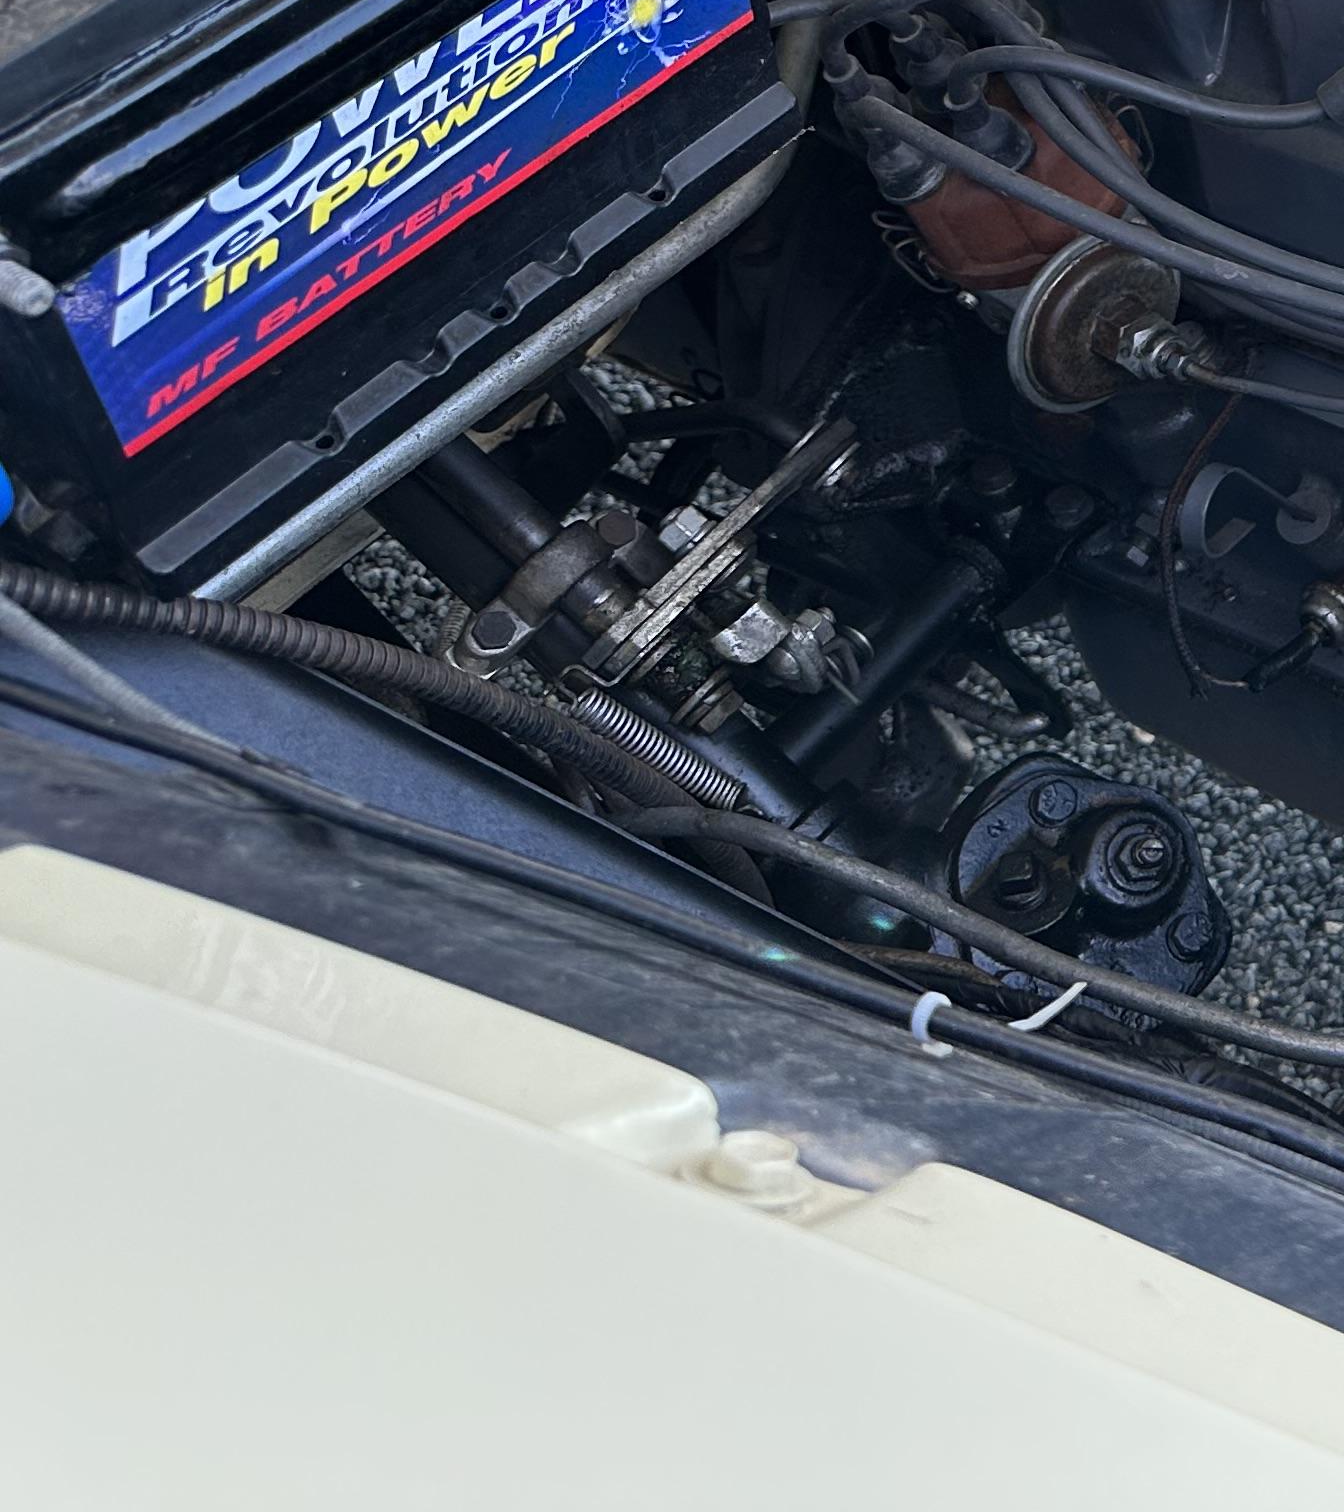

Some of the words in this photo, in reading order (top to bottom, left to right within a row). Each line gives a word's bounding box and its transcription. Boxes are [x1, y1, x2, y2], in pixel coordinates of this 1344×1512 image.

[146, 336, 240, 418] MF
[255, 148, 513, 341] BATTERY
[203, 237, 280, 313] in
